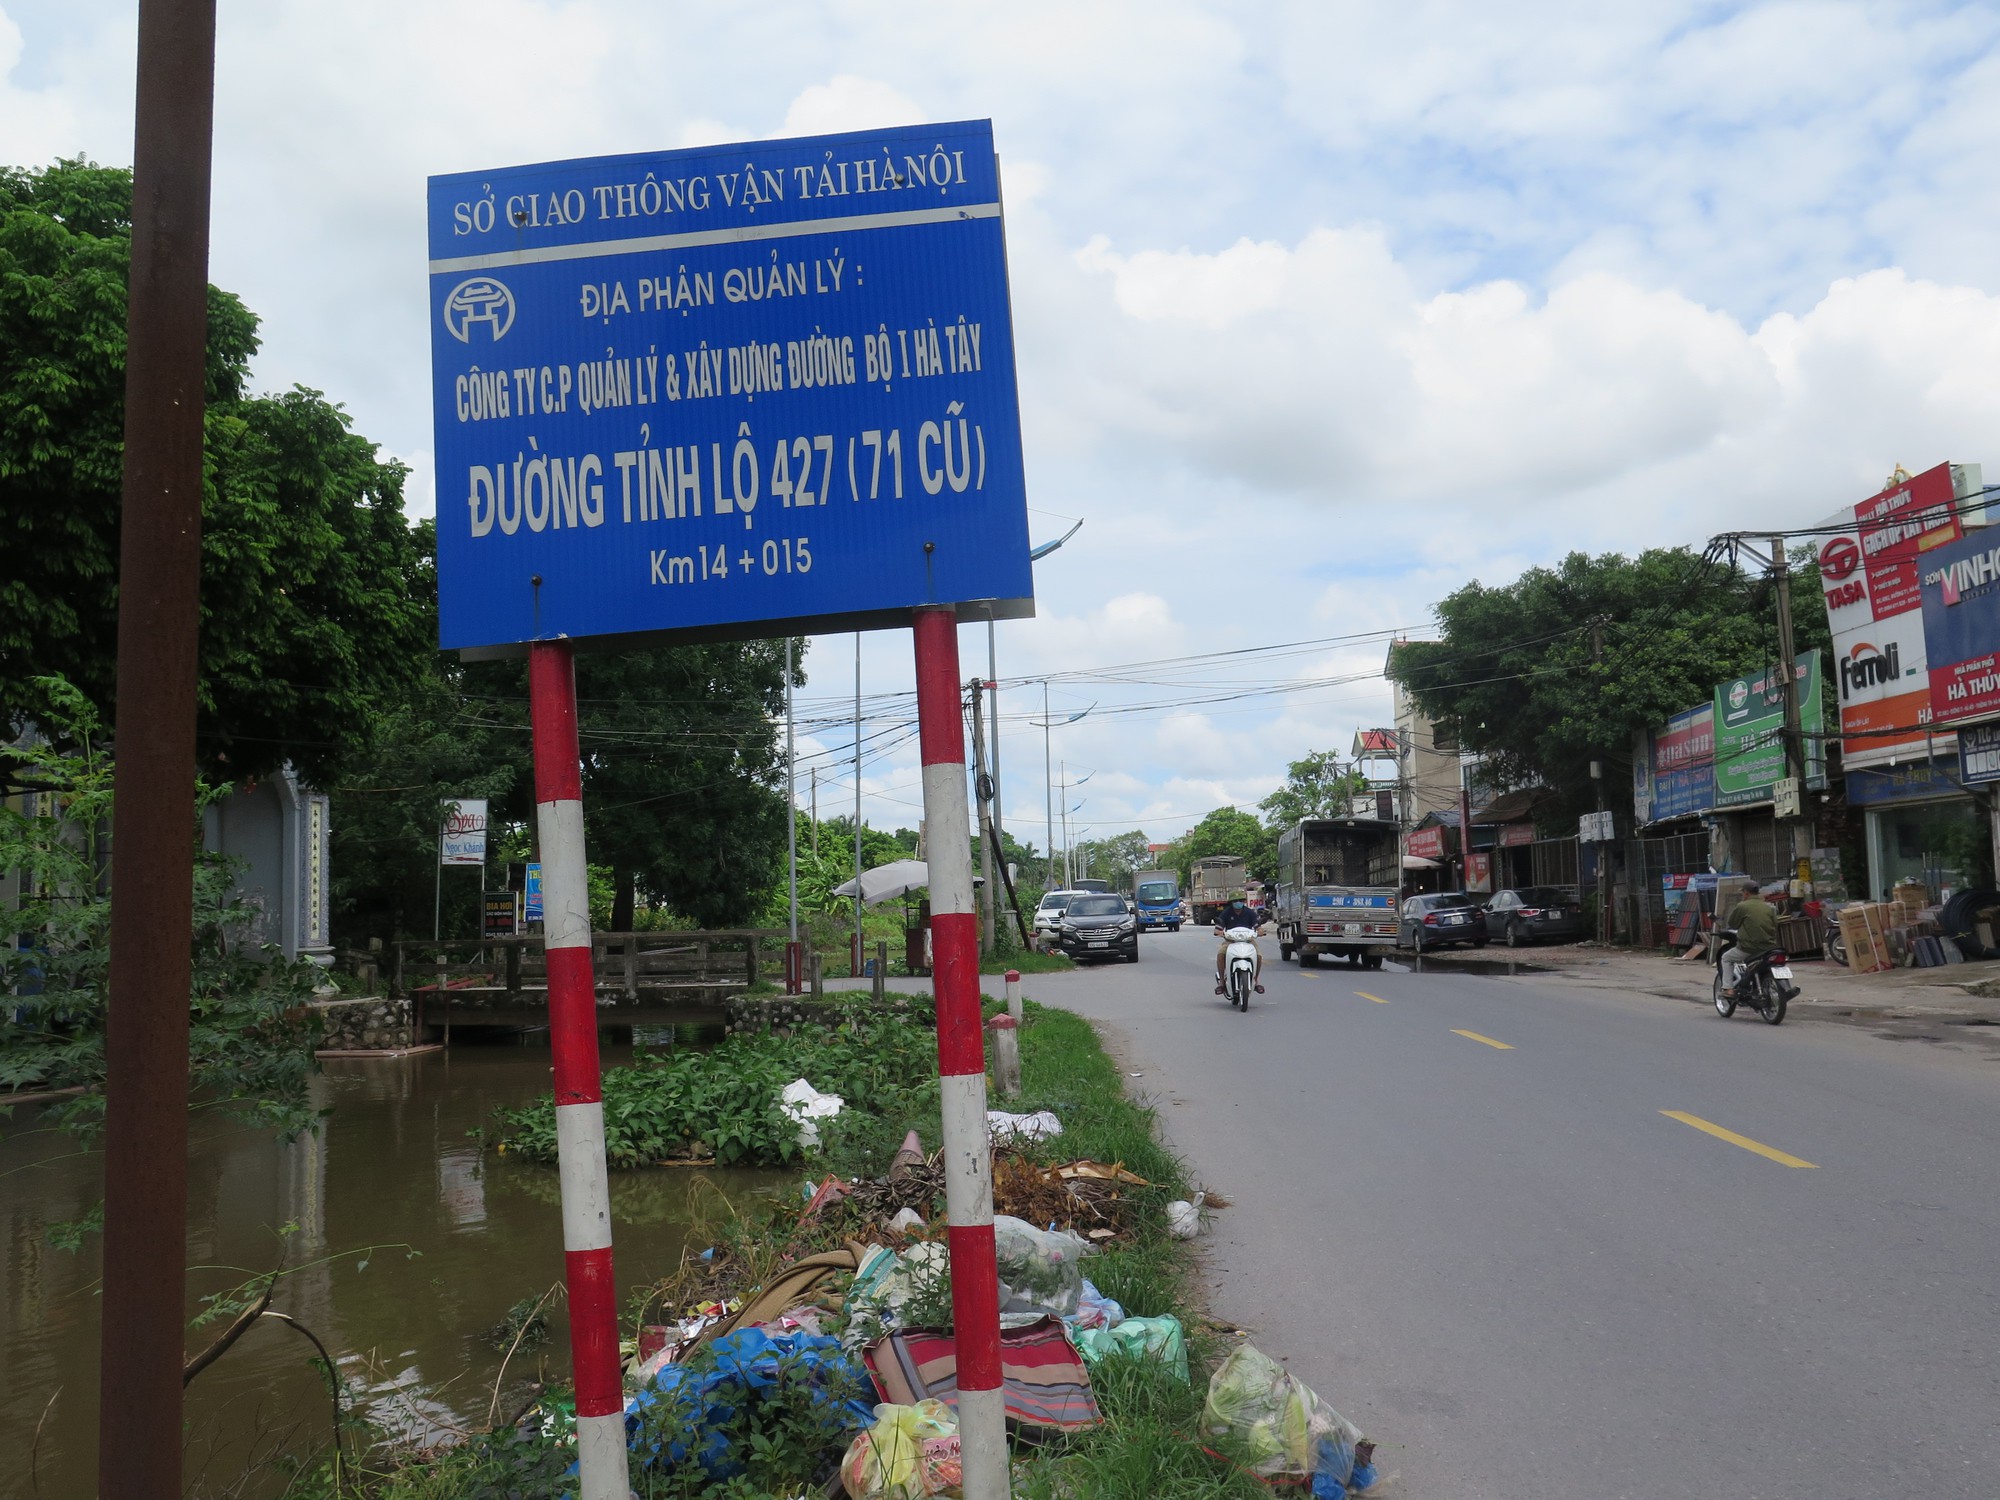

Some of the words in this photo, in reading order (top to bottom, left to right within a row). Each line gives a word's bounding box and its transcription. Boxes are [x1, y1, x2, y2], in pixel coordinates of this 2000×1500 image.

[455, 184, 495, 235] SỞ
[507, 190, 585, 228] GIAO
[593, 173, 710, 219] THÔNG
[716, 164, 783, 212] VẬN
[794, 151, 849, 198] TẢI
[854, 147, 901, 192] HÀ
[904, 144, 966, 194] NỘI
[580, 282, 630, 324] ĐỊA
[639, 265, 713, 316] PHẬN
[724, 250, 806, 302] QUẢN
[816, 247, 844, 292] LÝ
[457, 366, 509, 422] CÔNG
[514, 368, 535, 415] TY
[541, 366, 571, 413] C.P
[579, 347, 631, 415] QUẢN
[637, 345, 657, 404] LÝ
[666, 353, 682, 401] &
[685, 341, 721, 398] XÂY
[729, 341, 782, 401] DỰNG
[788, 326, 855, 388] ĐƯỜNG
[865, 324, 892, 391] BỘ
[914, 318, 943, 376] HÀ
[946, 315, 980, 373] TÂY
[469, 437, 603, 537] ĐƯỜNG
[615, 423, 701, 522] TỈNH
[713, 422, 758, 529] LỘ
[772, 436, 832, 507] 427
[849, 430, 902, 501] (71
[919, 401, 985, 494] CŨ)
[651, 545, 727, 584] Km14
[763, 538, 811, 575] 015
[1825, 580, 1867, 610] TASA
[1947, 676, 1968, 701] HÀ
[448, 811, 484, 839] Spa
